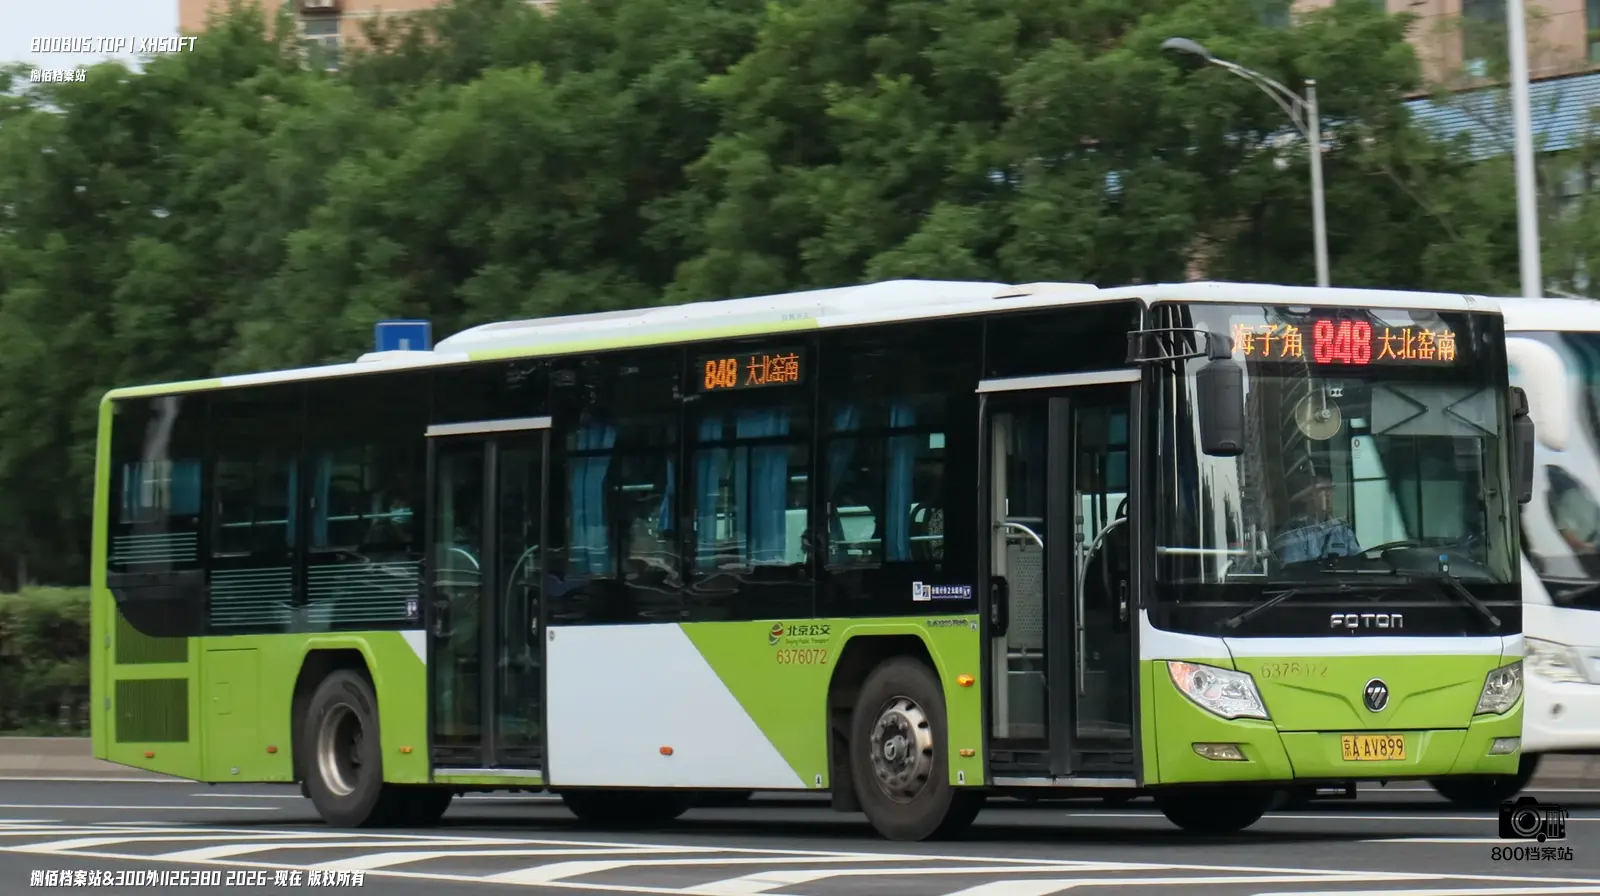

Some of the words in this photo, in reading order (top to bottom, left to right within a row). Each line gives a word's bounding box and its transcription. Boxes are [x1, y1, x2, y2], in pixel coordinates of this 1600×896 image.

[1231, 324, 1303, 358] 海子角
[1314, 320, 1372, 365] 848
[1377, 328, 1456, 361] 大北窑南
[704, 359, 738, 390] 848
[744, 353, 800, 386] 大北窑南
[1330, 614, 1404, 629] FOTON
[787, 625, 831, 636] 北京公交
[776, 649, 828, 665] 6376072
